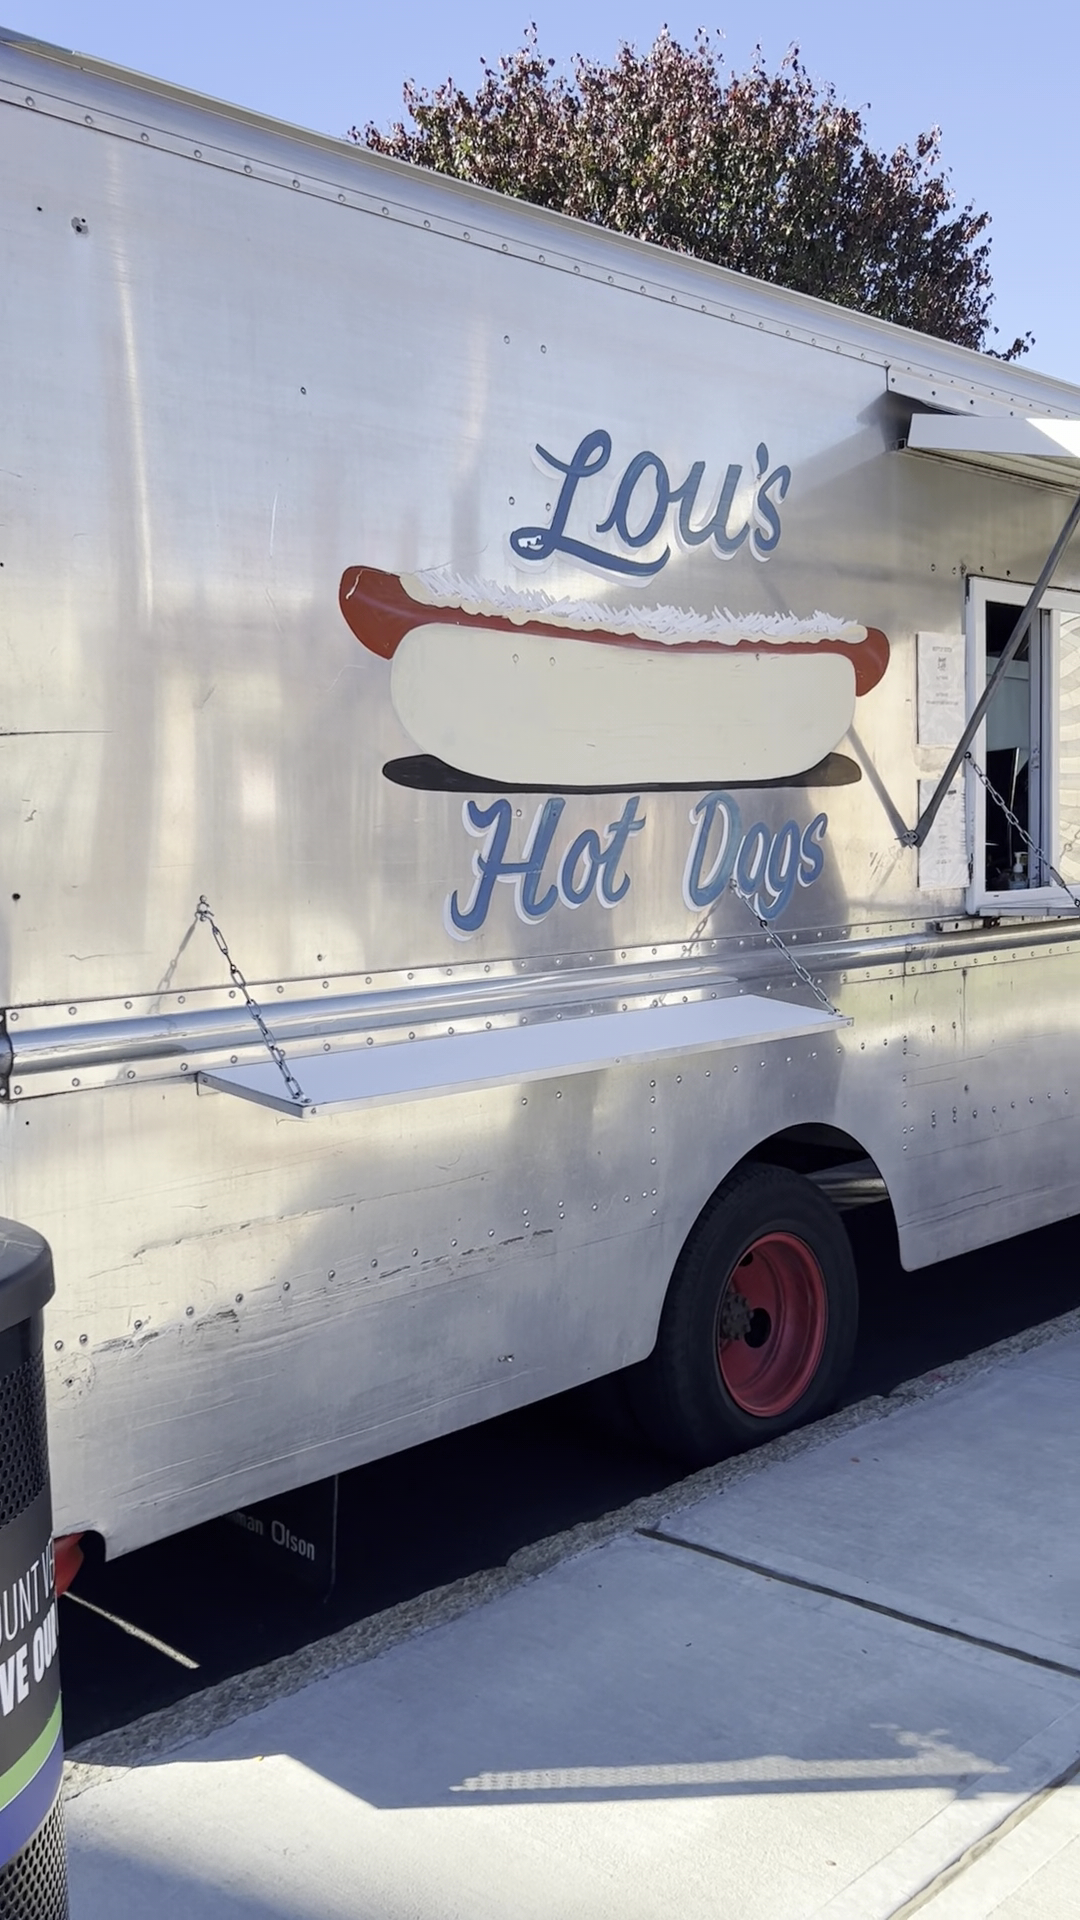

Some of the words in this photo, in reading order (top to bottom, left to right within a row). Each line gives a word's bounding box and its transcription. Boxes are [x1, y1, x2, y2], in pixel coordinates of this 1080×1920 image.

[509, 428, 792, 581] Lou's
[445, 795, 648, 939] Hot
[683, 792, 829, 921] Dogs
[271, 1519, 315, 1561] Olson
[0, 1560, 39, 1646] UNT
